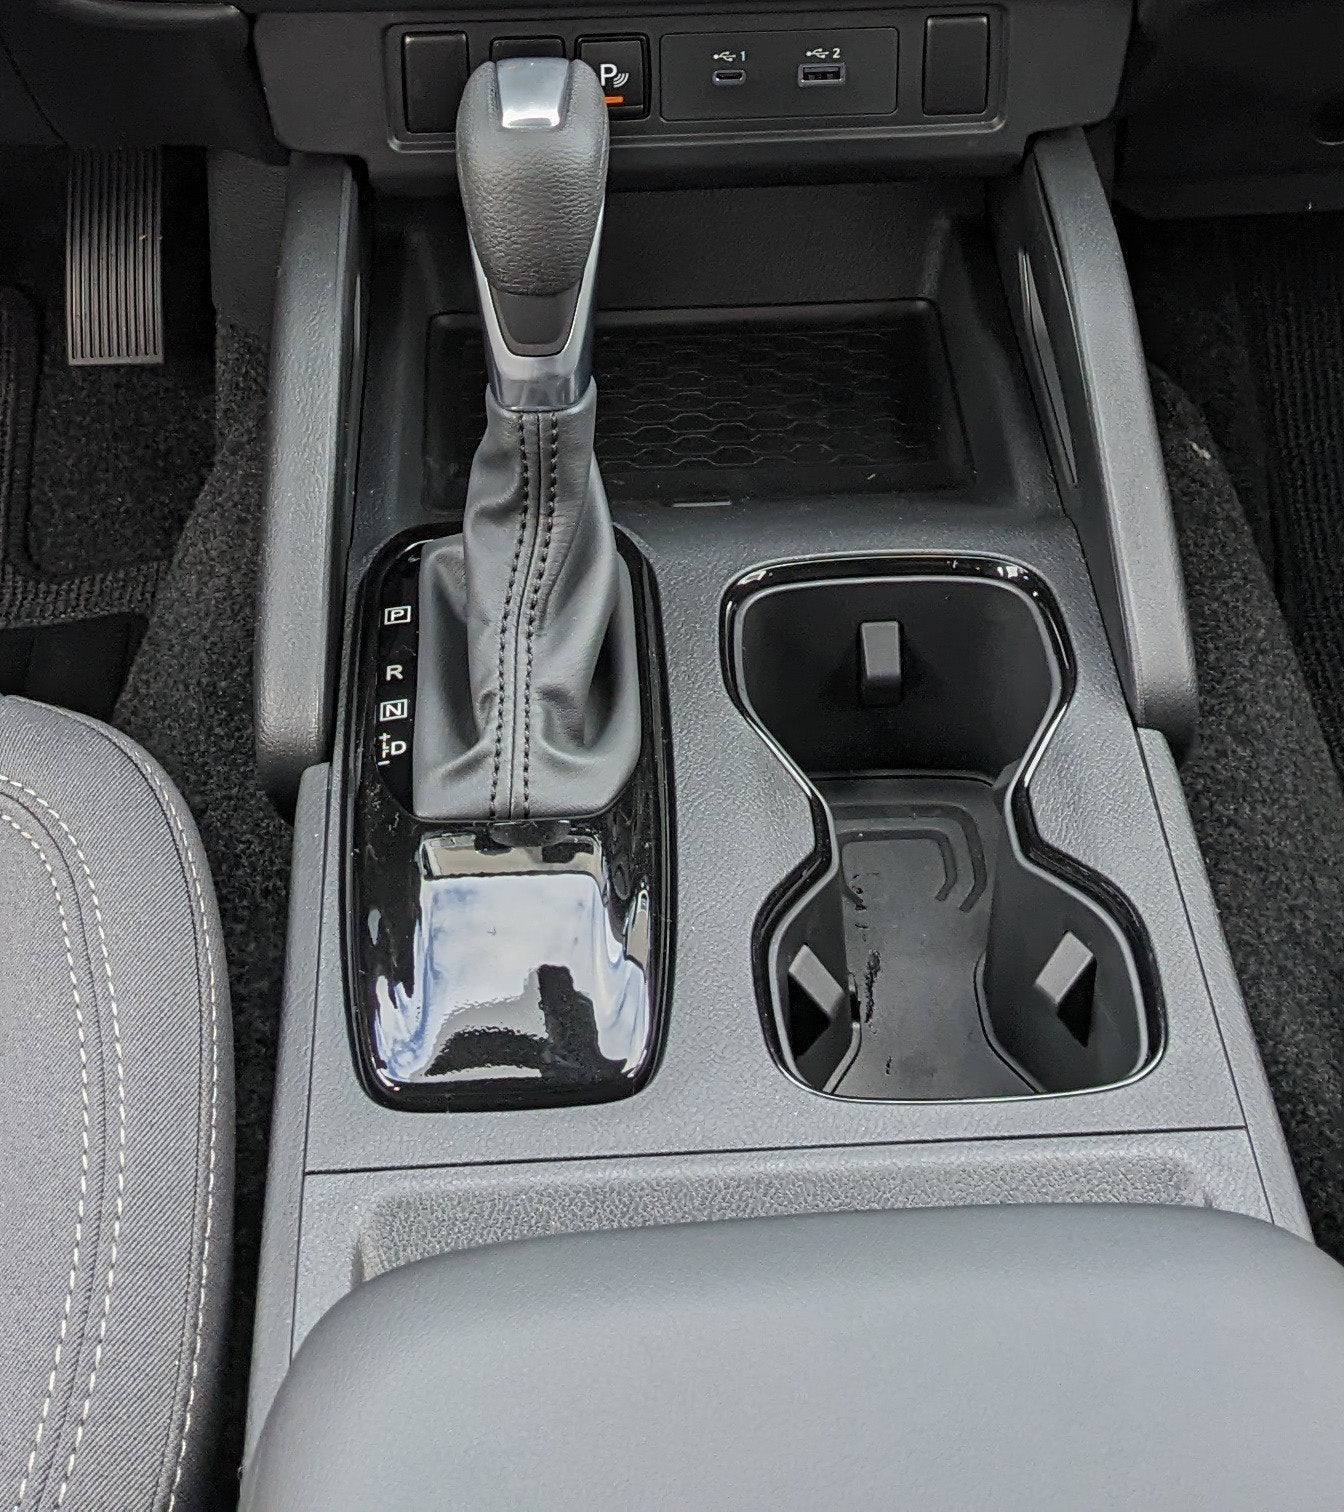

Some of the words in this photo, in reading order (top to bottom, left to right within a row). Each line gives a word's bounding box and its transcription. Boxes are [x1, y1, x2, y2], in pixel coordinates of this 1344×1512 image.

[739, 51, 747, 62] 1
[832, 49, 841, 59] 2
[385, 664, 404, 681] R
[390, 740, 407, 756] D
